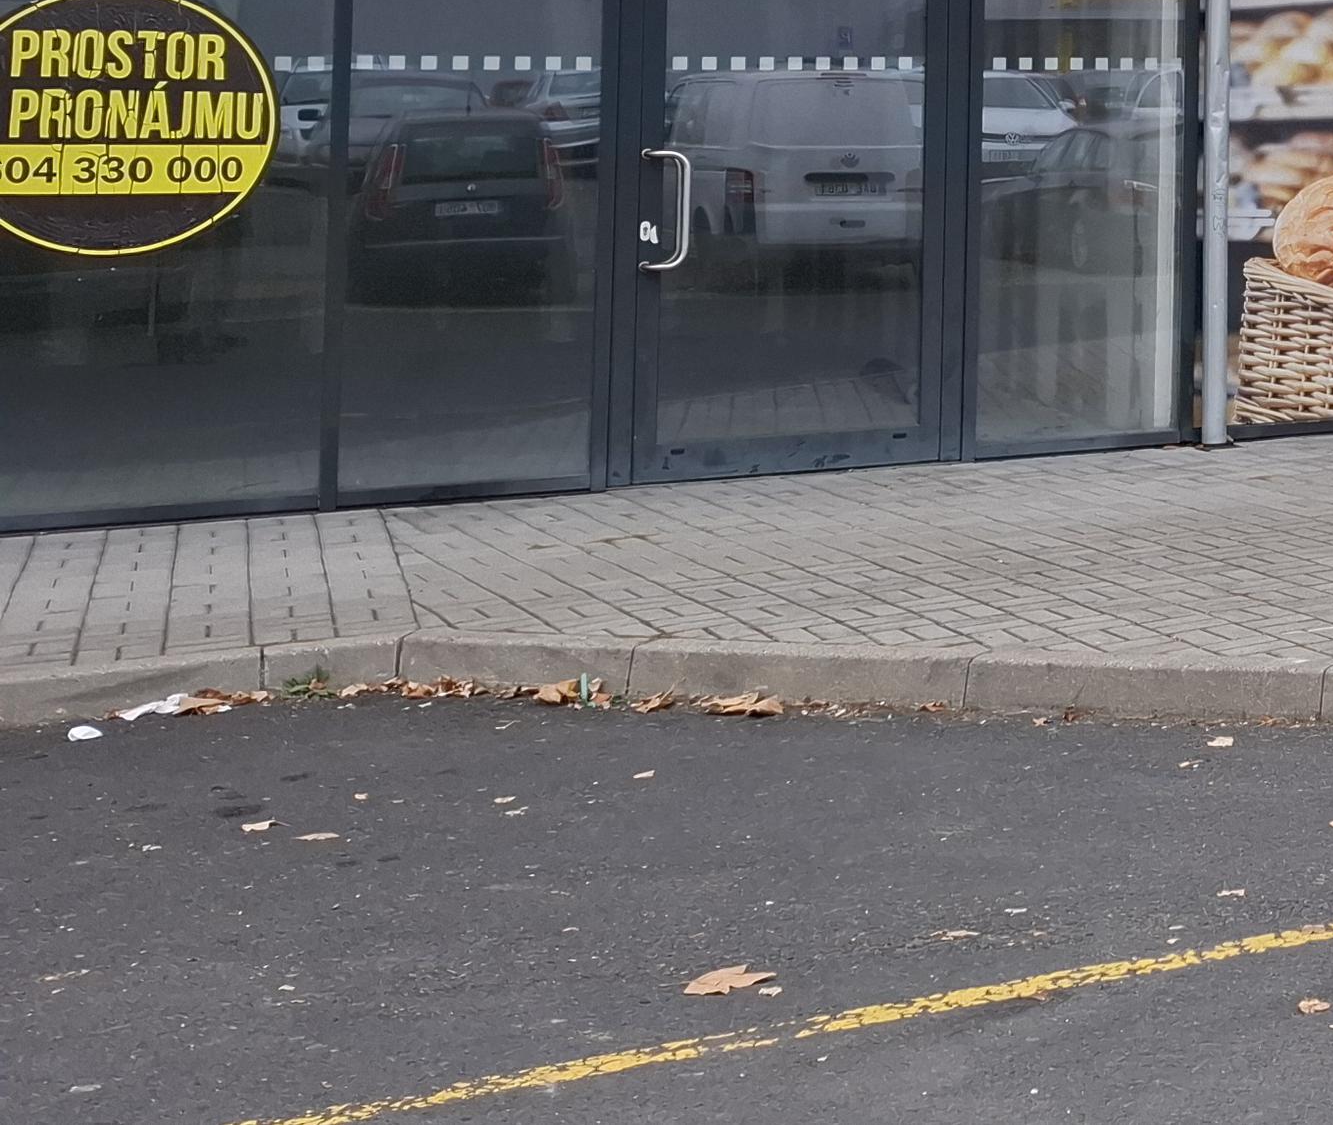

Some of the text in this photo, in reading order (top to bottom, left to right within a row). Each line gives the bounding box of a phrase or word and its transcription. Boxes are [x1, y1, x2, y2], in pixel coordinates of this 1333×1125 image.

[10, 28, 226, 80] PROSTOR
[8, 81, 264, 139] PRONÁJMU
[72, 156, 153, 183] 330
[167, 156, 243, 183] 000
